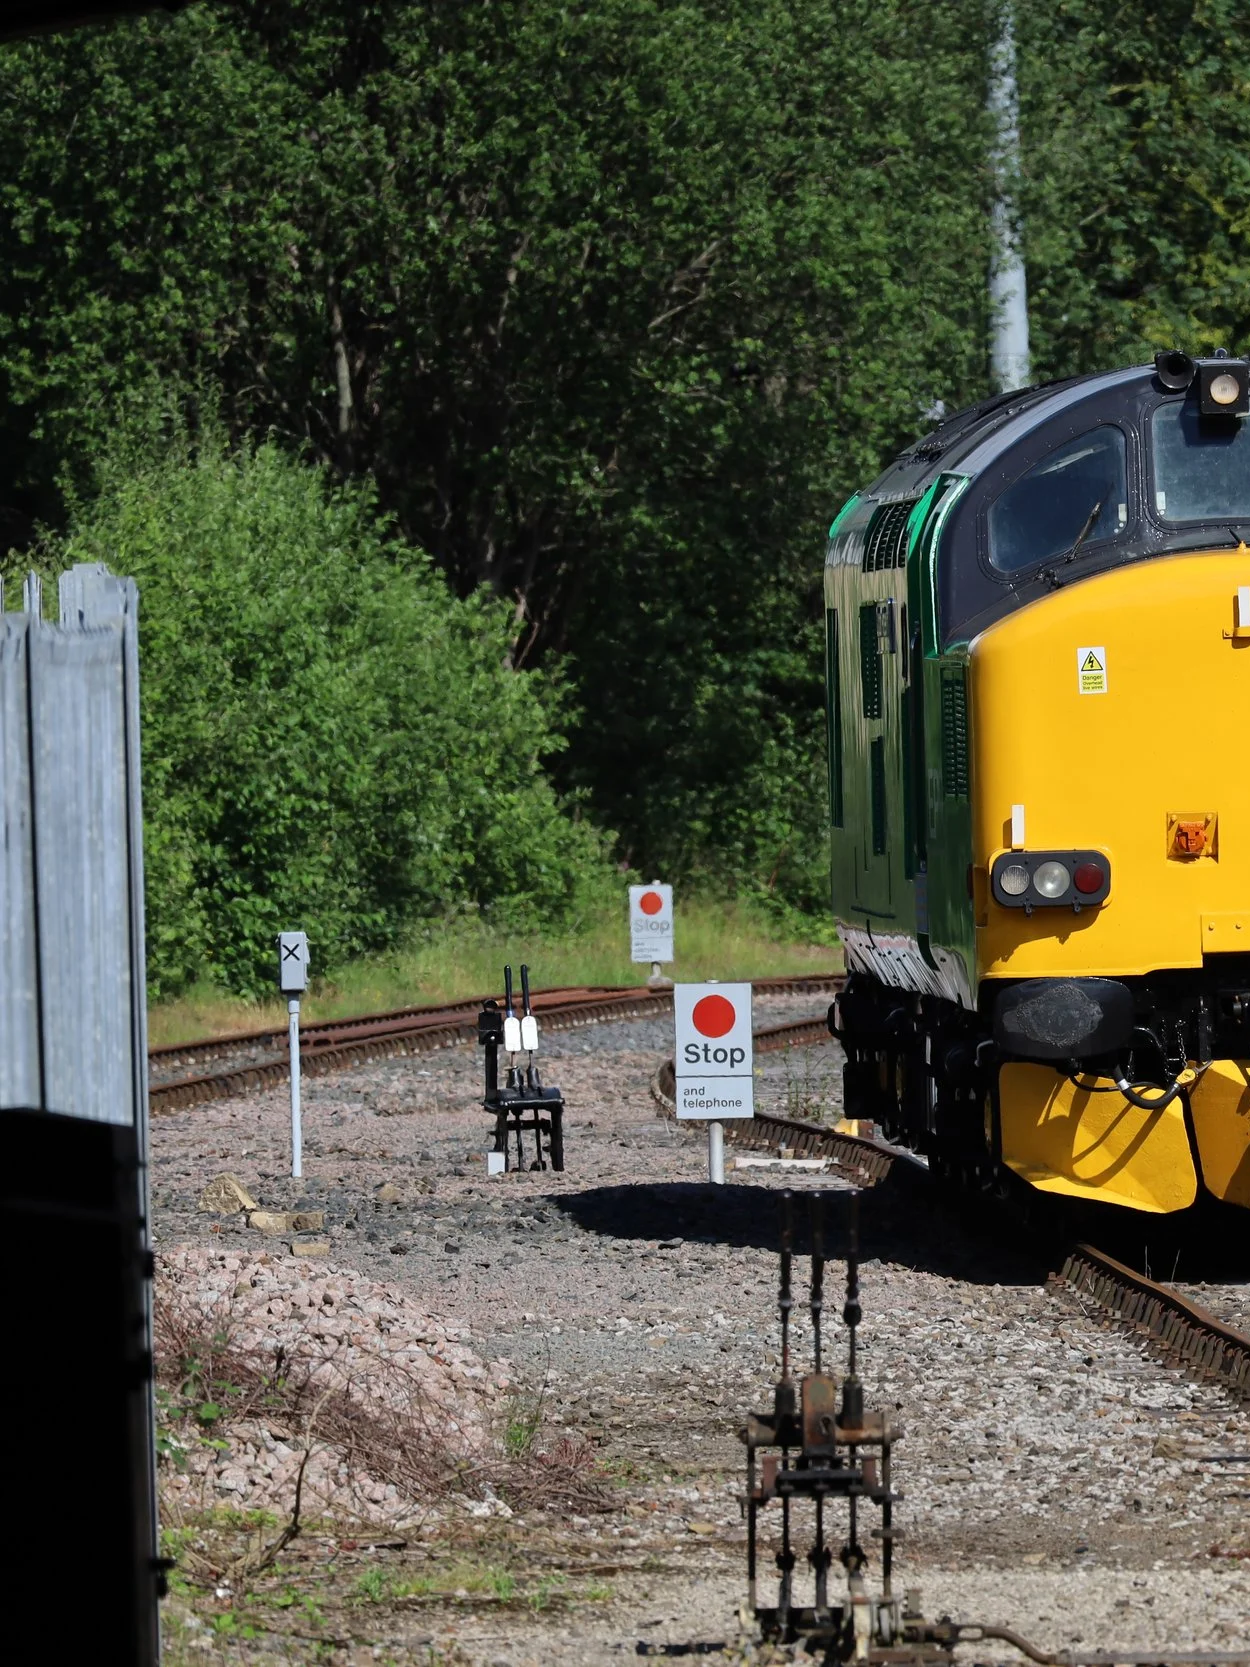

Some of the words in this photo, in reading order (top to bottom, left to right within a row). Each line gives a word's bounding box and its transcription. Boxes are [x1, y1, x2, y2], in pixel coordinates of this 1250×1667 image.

[633, 919, 670, 934] Stop
[684, 1043, 746, 1068] Stop
[683, 1086, 705, 1096] and
[683, 1098, 742, 1109] telephone
